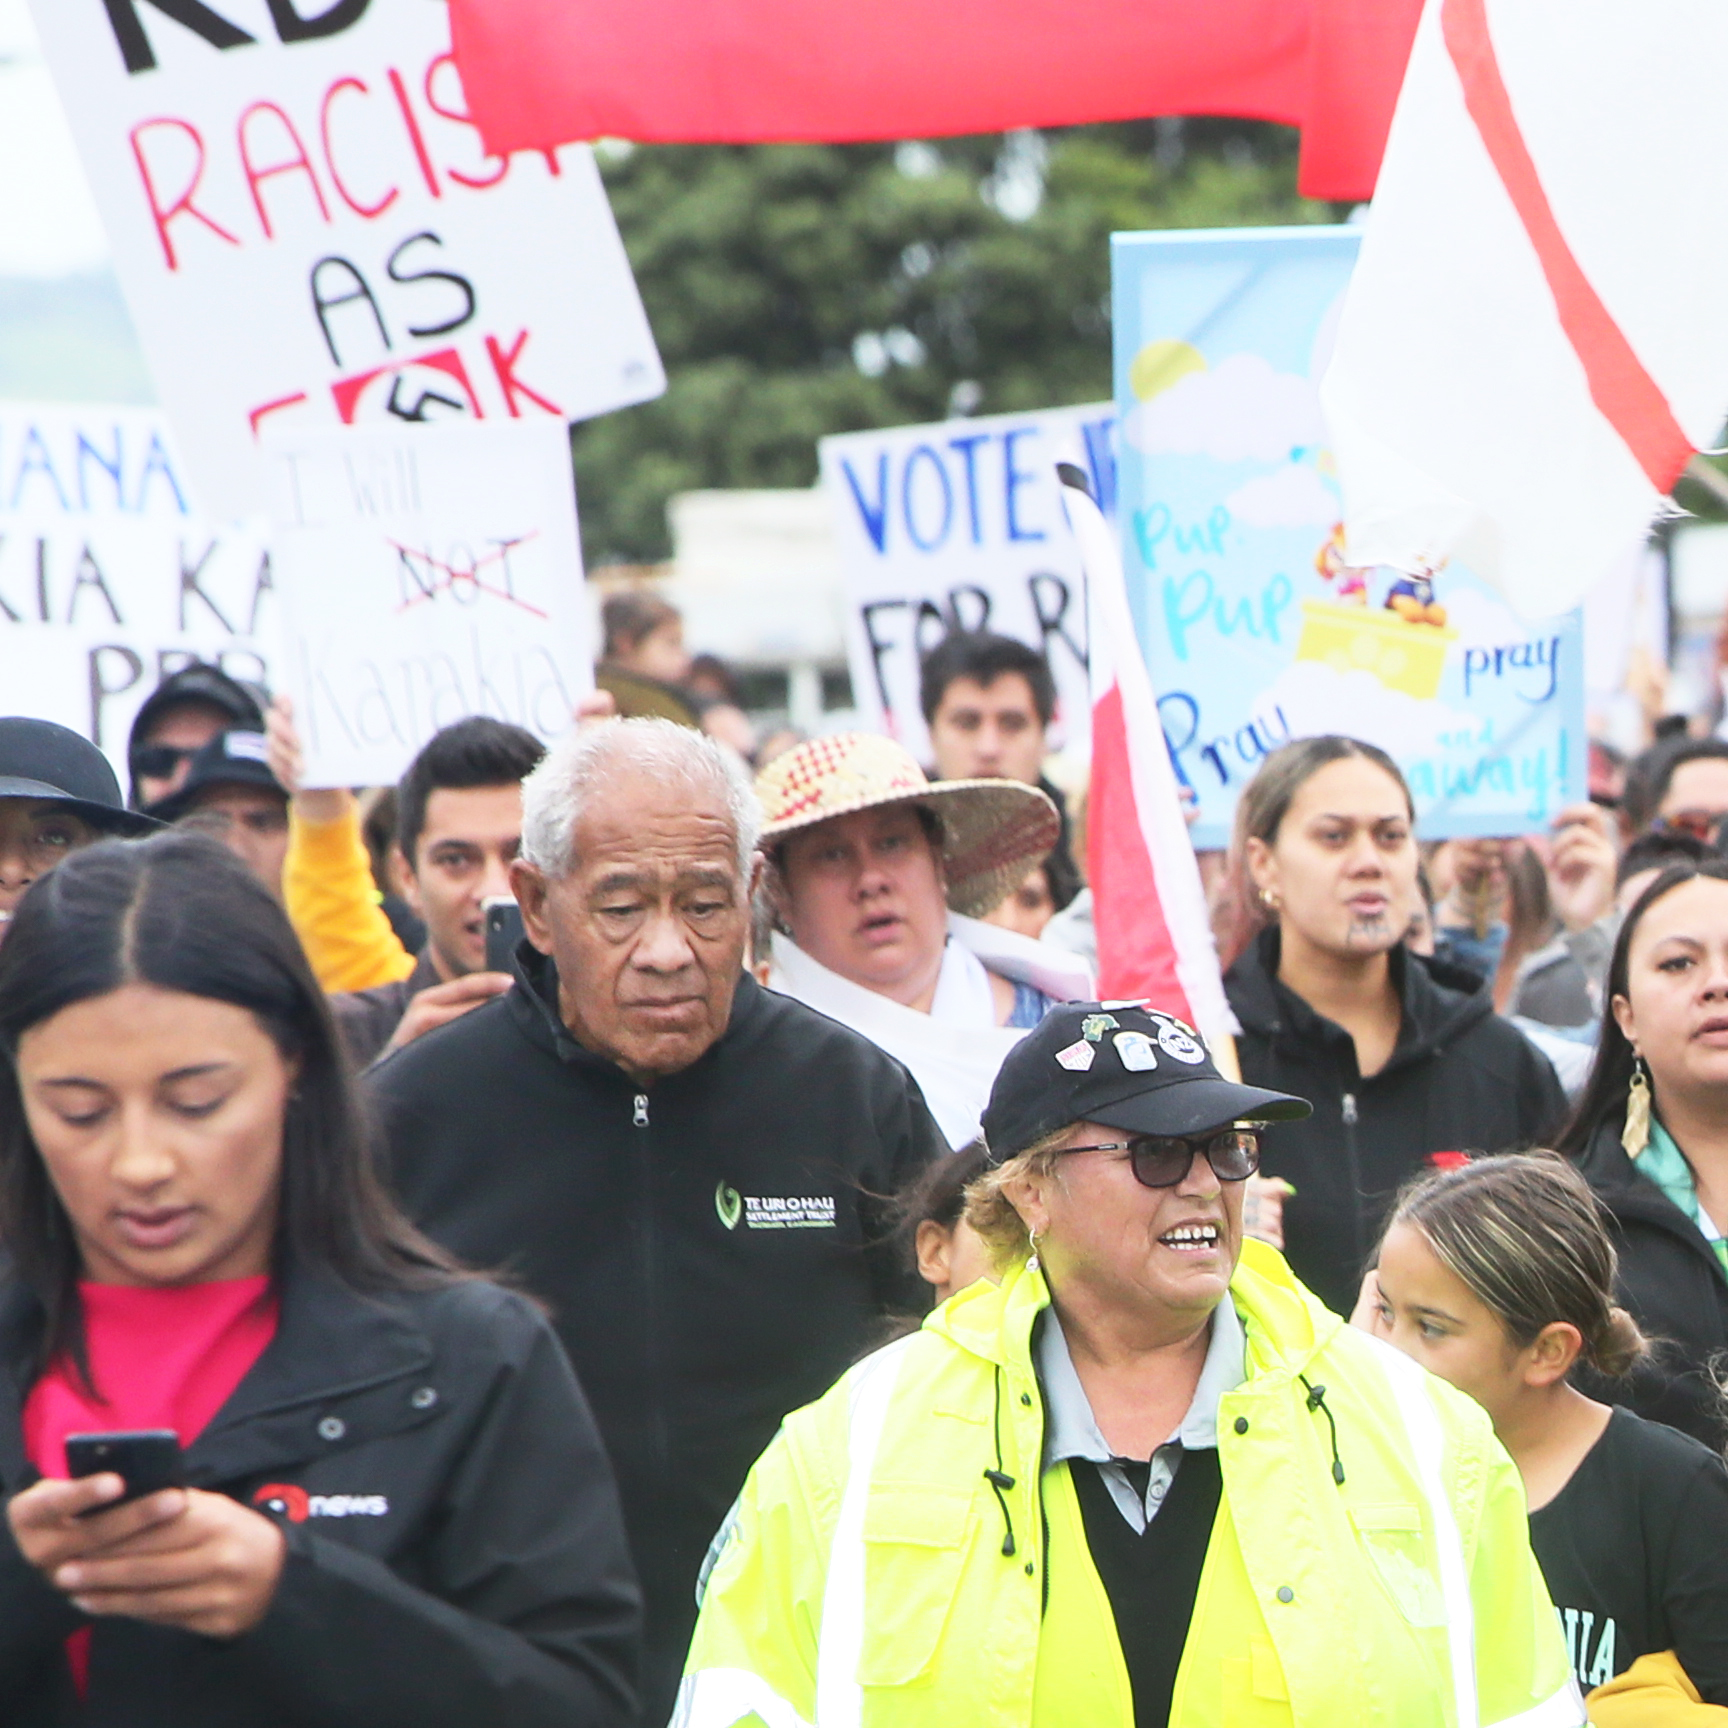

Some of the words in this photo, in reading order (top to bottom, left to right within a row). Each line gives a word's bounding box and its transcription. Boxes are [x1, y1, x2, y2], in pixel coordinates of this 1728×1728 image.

[129, 46, 562, 271] RACIS
[309, 230, 477, 368] AS
[839, 423, 1048, 554] VOTE
[395, 535, 526, 607] NOT
[1463, 634, 1562, 706] pray
[309, 1494, 388, 1518] news
